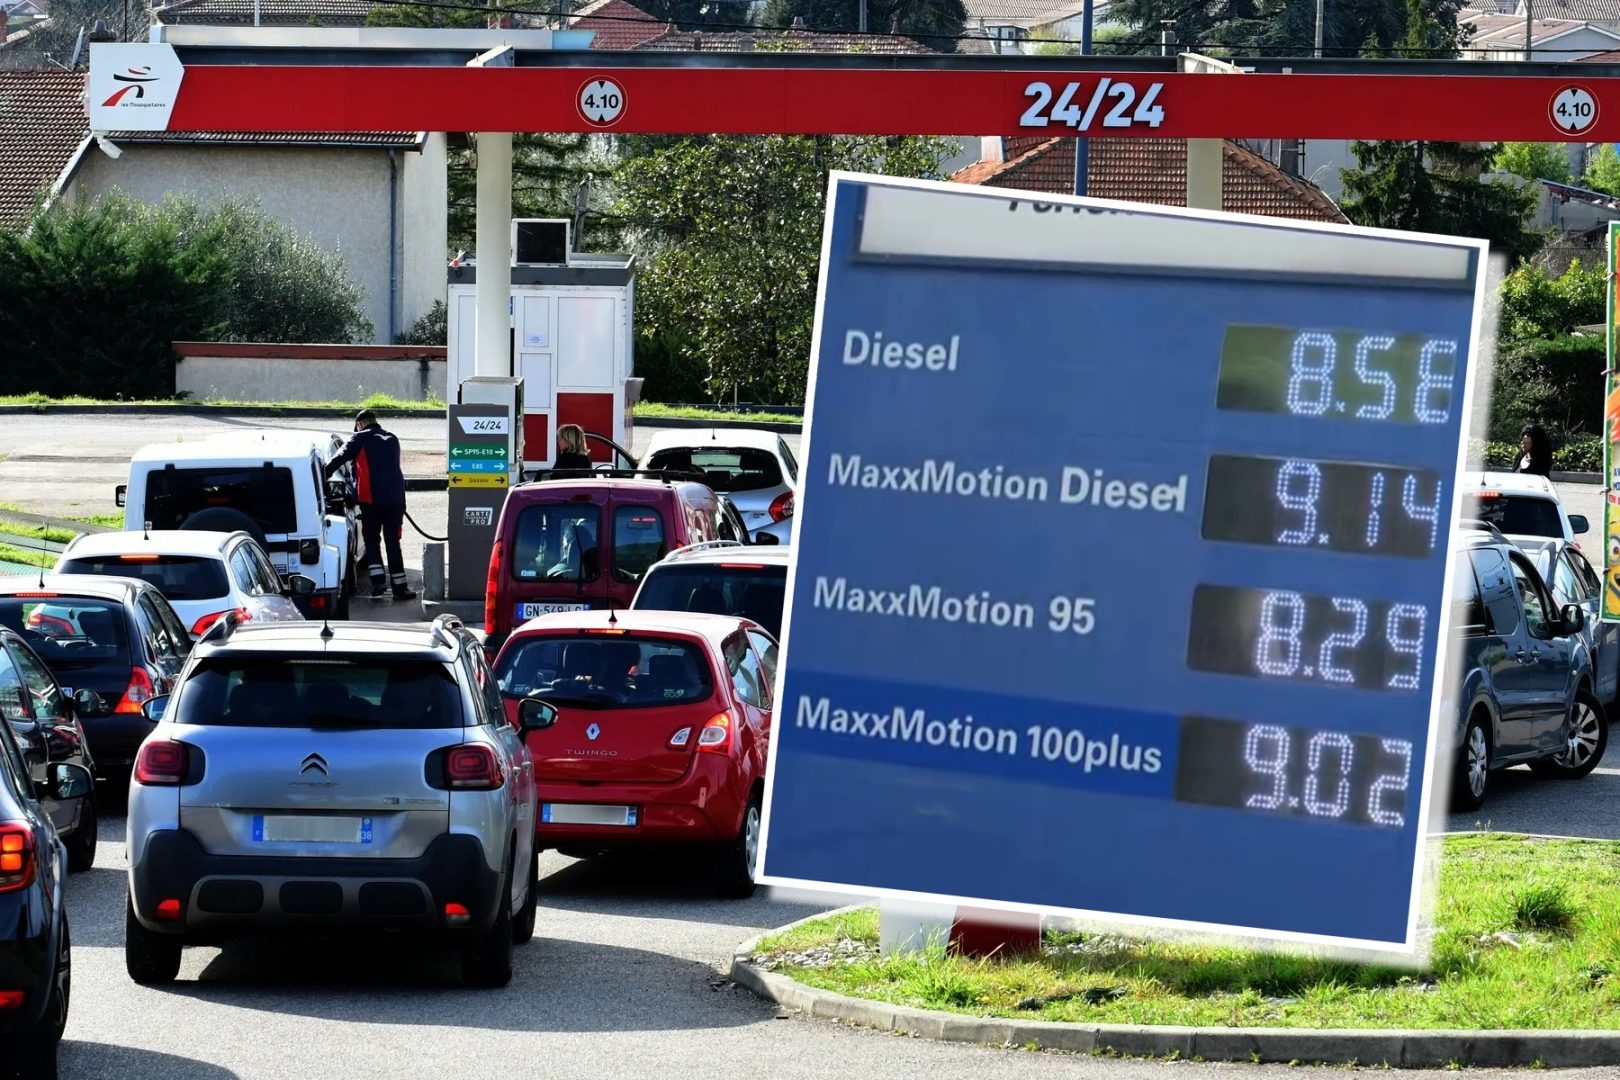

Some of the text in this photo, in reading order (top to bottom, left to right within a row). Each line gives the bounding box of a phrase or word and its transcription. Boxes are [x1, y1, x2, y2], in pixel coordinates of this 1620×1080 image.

[584, 93, 619, 109] 4.10
[1019, 77, 1165, 131] 24/24
[1556, 102, 1591, 117] 4.10
[843, 330, 960, 371] Diesel
[463, 448, 494, 456] SP95-E10
[473, 421, 502, 430] 24/24
[828, 453, 1188, 512] MaxxMotion Diesel
[1276, 460, 1442, 549] 9.14
[813, 576, 1096, 635] MaxxMotion 95
[1255, 591, 1428, 690] 8.29
[796, 696, 1162, 774] MaxxMotion 100plus
[1244, 724, 1414, 828] 9.02
[361, 831, 372, 840] 38
